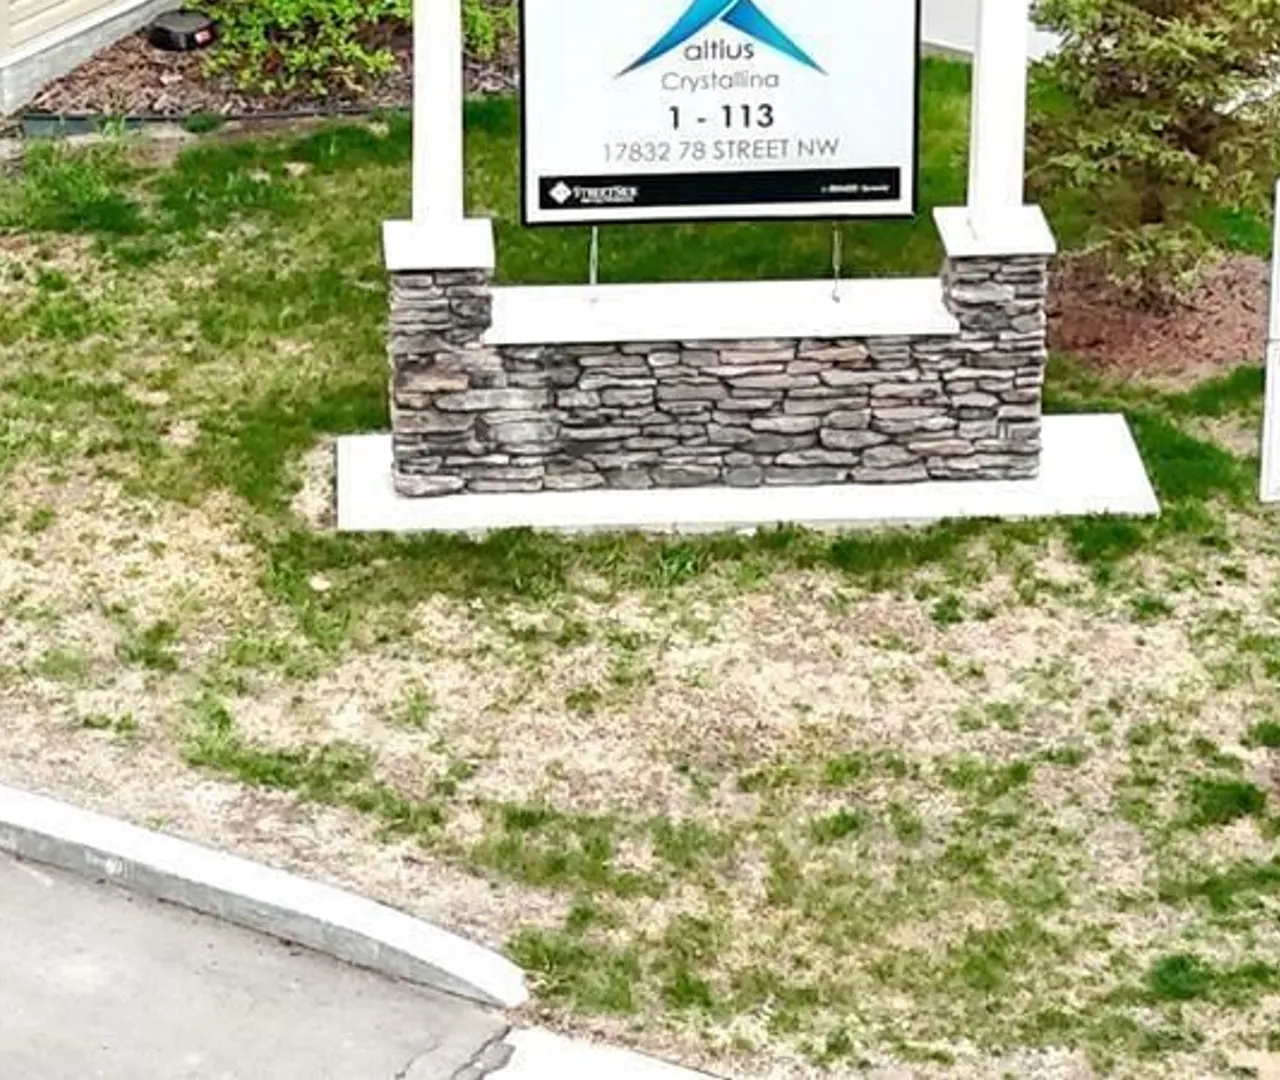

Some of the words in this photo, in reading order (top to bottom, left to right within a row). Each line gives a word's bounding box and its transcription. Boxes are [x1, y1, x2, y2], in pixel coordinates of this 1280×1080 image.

[683, 38, 754, 62] altius
[660, 70, 780, 93] Crystallina
[668, 105, 680, 131] 1
[720, 103, 775, 129] 113
[603, 141, 671, 163] 17832
[678, 139, 707, 162] 78
[712, 138, 790, 161] STREET
[797, 137, 840, 159] NW
